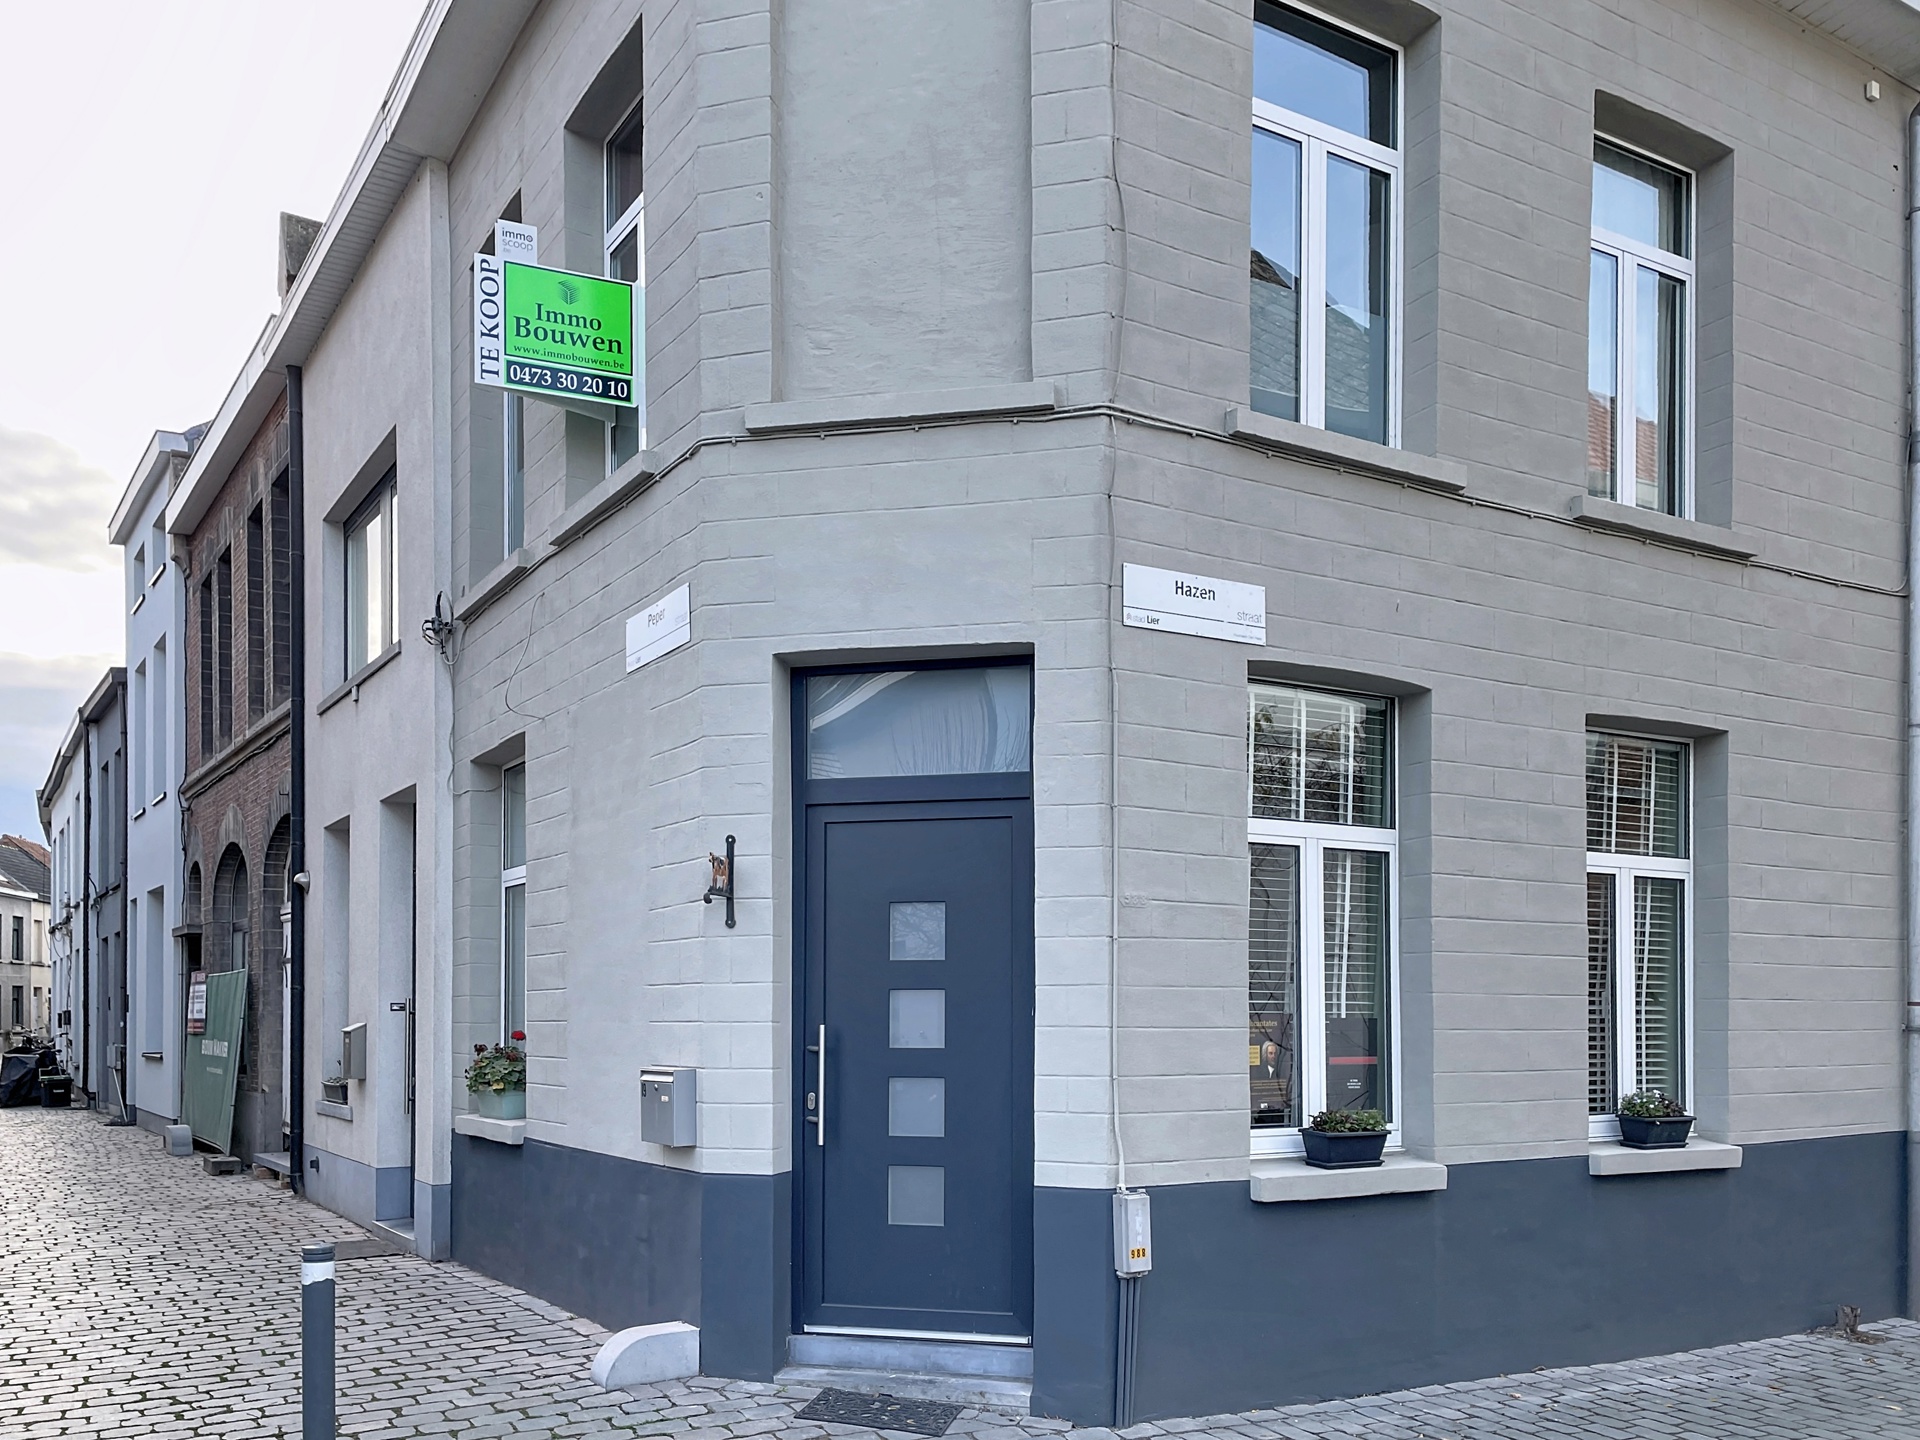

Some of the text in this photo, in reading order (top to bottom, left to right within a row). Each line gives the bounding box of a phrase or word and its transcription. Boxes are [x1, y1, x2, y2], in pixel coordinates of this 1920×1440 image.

[501, 227, 534, 242] immo
[502, 238, 534, 252] scoop
[480, 258, 500, 380] TE KOOP
[534, 302, 602, 332] Immo
[513, 315, 624, 356] Bouwen
[513, 345, 625, 370] www.immobouwen.be
[510, 364, 628, 399] 0473 30 20 10
[1174, 580, 1216, 602] Hazen
[648, 608, 666, 628] Peper
[1146, 615, 1160, 626] Lier
[1236, 610, 1262, 624] straat
[1131, 1248, 1145, 1259] 988
